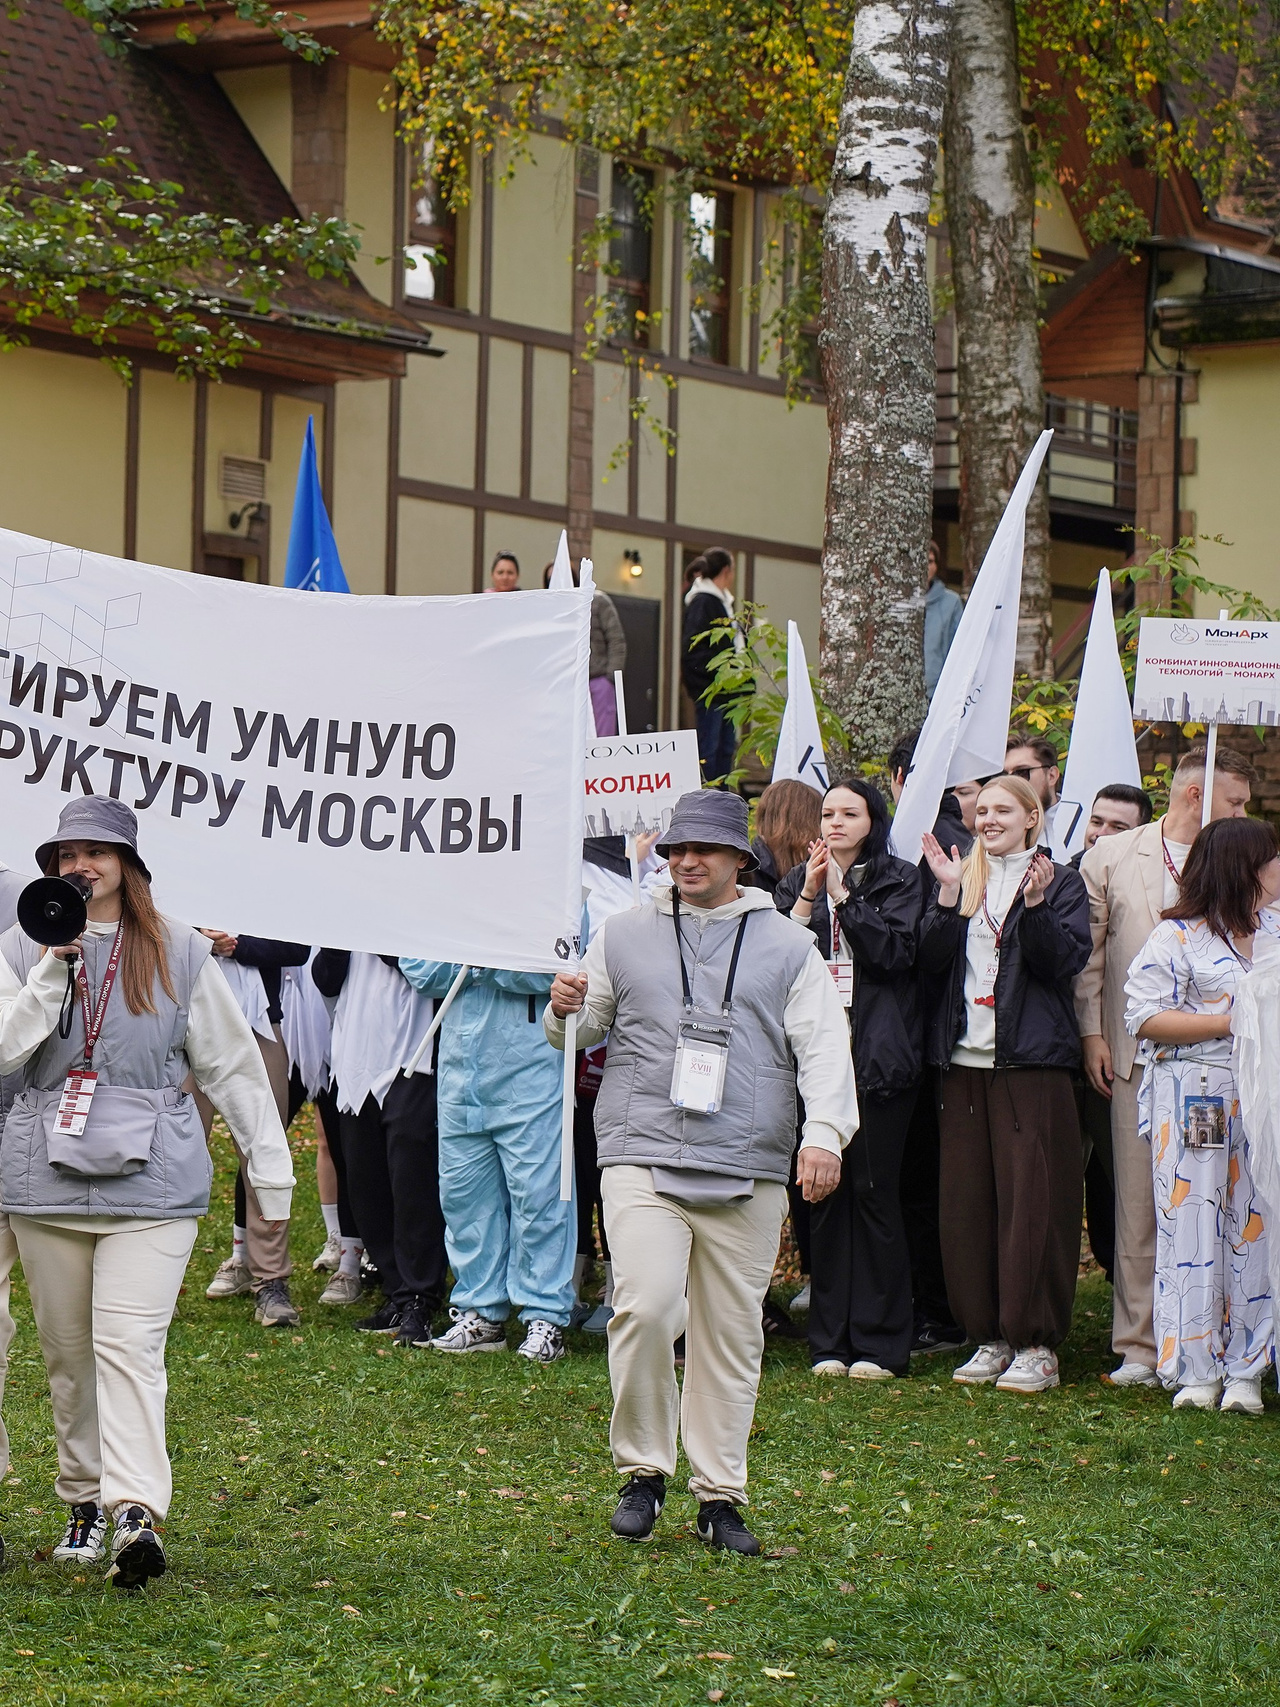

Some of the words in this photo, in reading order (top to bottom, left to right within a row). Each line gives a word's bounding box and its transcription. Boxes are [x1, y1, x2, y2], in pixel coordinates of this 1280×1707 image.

[1205, 628, 1268, 640] МонАрх
[1145, 658, 1198, 667] КОМБИНАТ
[1159, 668, 1223, 677] ТЕХНОЛОГИЙ
[1234, 671, 1275, 679] МОНАРХ
[231, 707, 455, 780] УМНУЮ
[585, 741, 676, 759] ОЛДИ
[584, 772, 671, 795] КОЛДИ
[262, 785, 522, 854] МОСКВЫ
[690, 1062, 712, 1073] XVIII
